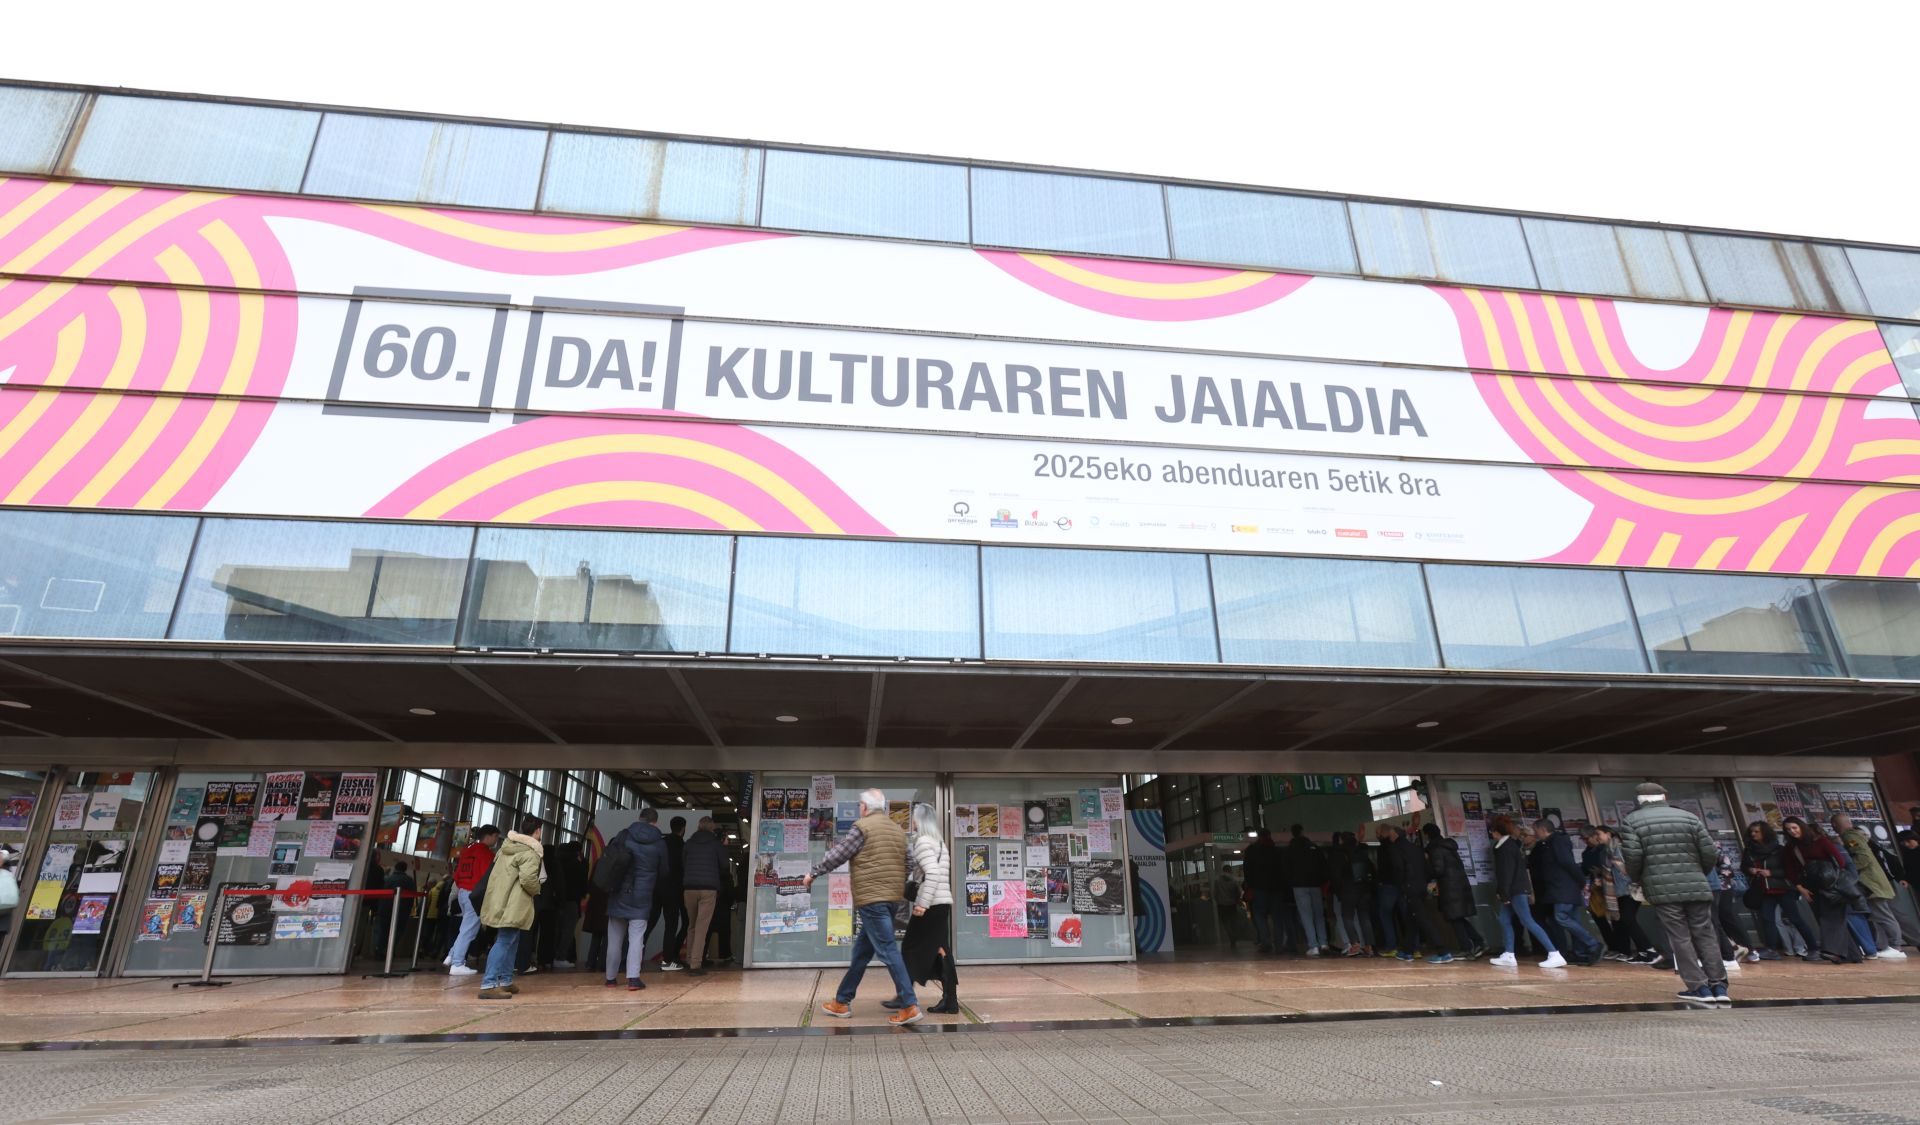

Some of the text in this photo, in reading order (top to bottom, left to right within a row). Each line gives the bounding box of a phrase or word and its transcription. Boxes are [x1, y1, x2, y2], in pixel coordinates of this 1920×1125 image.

[363, 323, 1429, 439] 60. DA! KULTURAREN JAIALDIA
[1033, 453, 1441, 497] 2025eko abenduaren 5etik 8ra
[341, 779, 375, 788] EUSKAL
